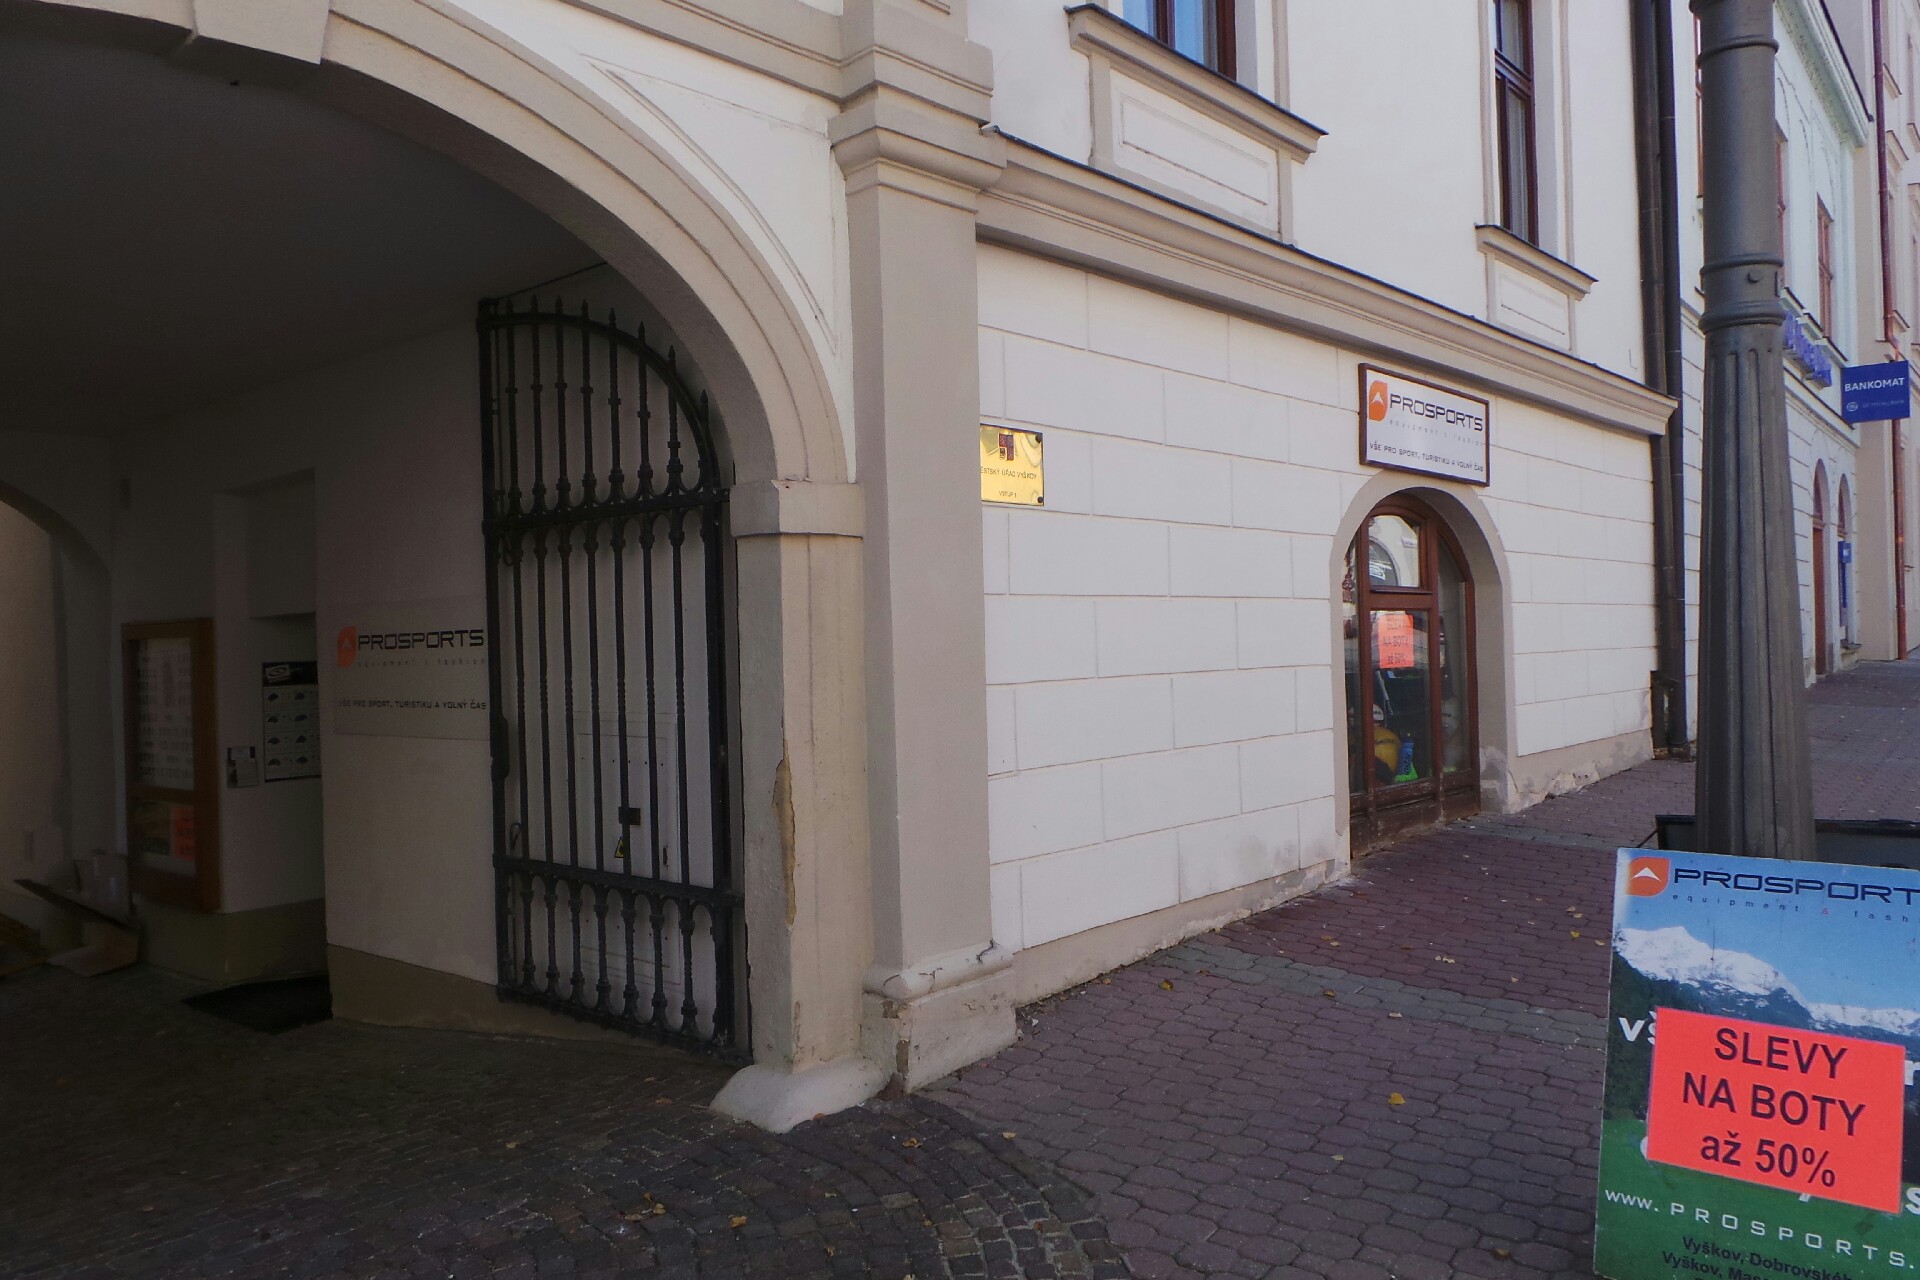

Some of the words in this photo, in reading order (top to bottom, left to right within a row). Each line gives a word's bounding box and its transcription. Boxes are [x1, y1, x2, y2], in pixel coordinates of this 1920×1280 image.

[1844, 377, 1905, 392] BANKOMAT
[1389, 393, 1483, 432] PROSPORTS
[1369, 441, 1382, 451] VŠE
[1384, 445, 1397, 454] PRO
[1422, 453, 1450, 465] TURISTIKU
[1474, 462, 1484, 472] ČAS
[358, 629, 484, 651] PROSPORTS
[395, 699, 432, 709] TURISTIKU
[434, 701, 440, 709] A
[443, 697, 467, 709] VOLNÝ
[471, 699, 486, 710] ČAS
[1672, 893, 1799, 912] equipment
[1714, 1027, 1848, 1080] SLEVY
[1682, 1071, 1737, 1114] NA
[1751, 1083, 1866, 1137] BOTY
[1701, 1130, 1741, 1167] až
[1755, 1138, 1836, 1188] 50%
[1662, 1250, 1723, 1279] Vyškov,
[1682, 1236, 1743, 1265] Vyškov,
